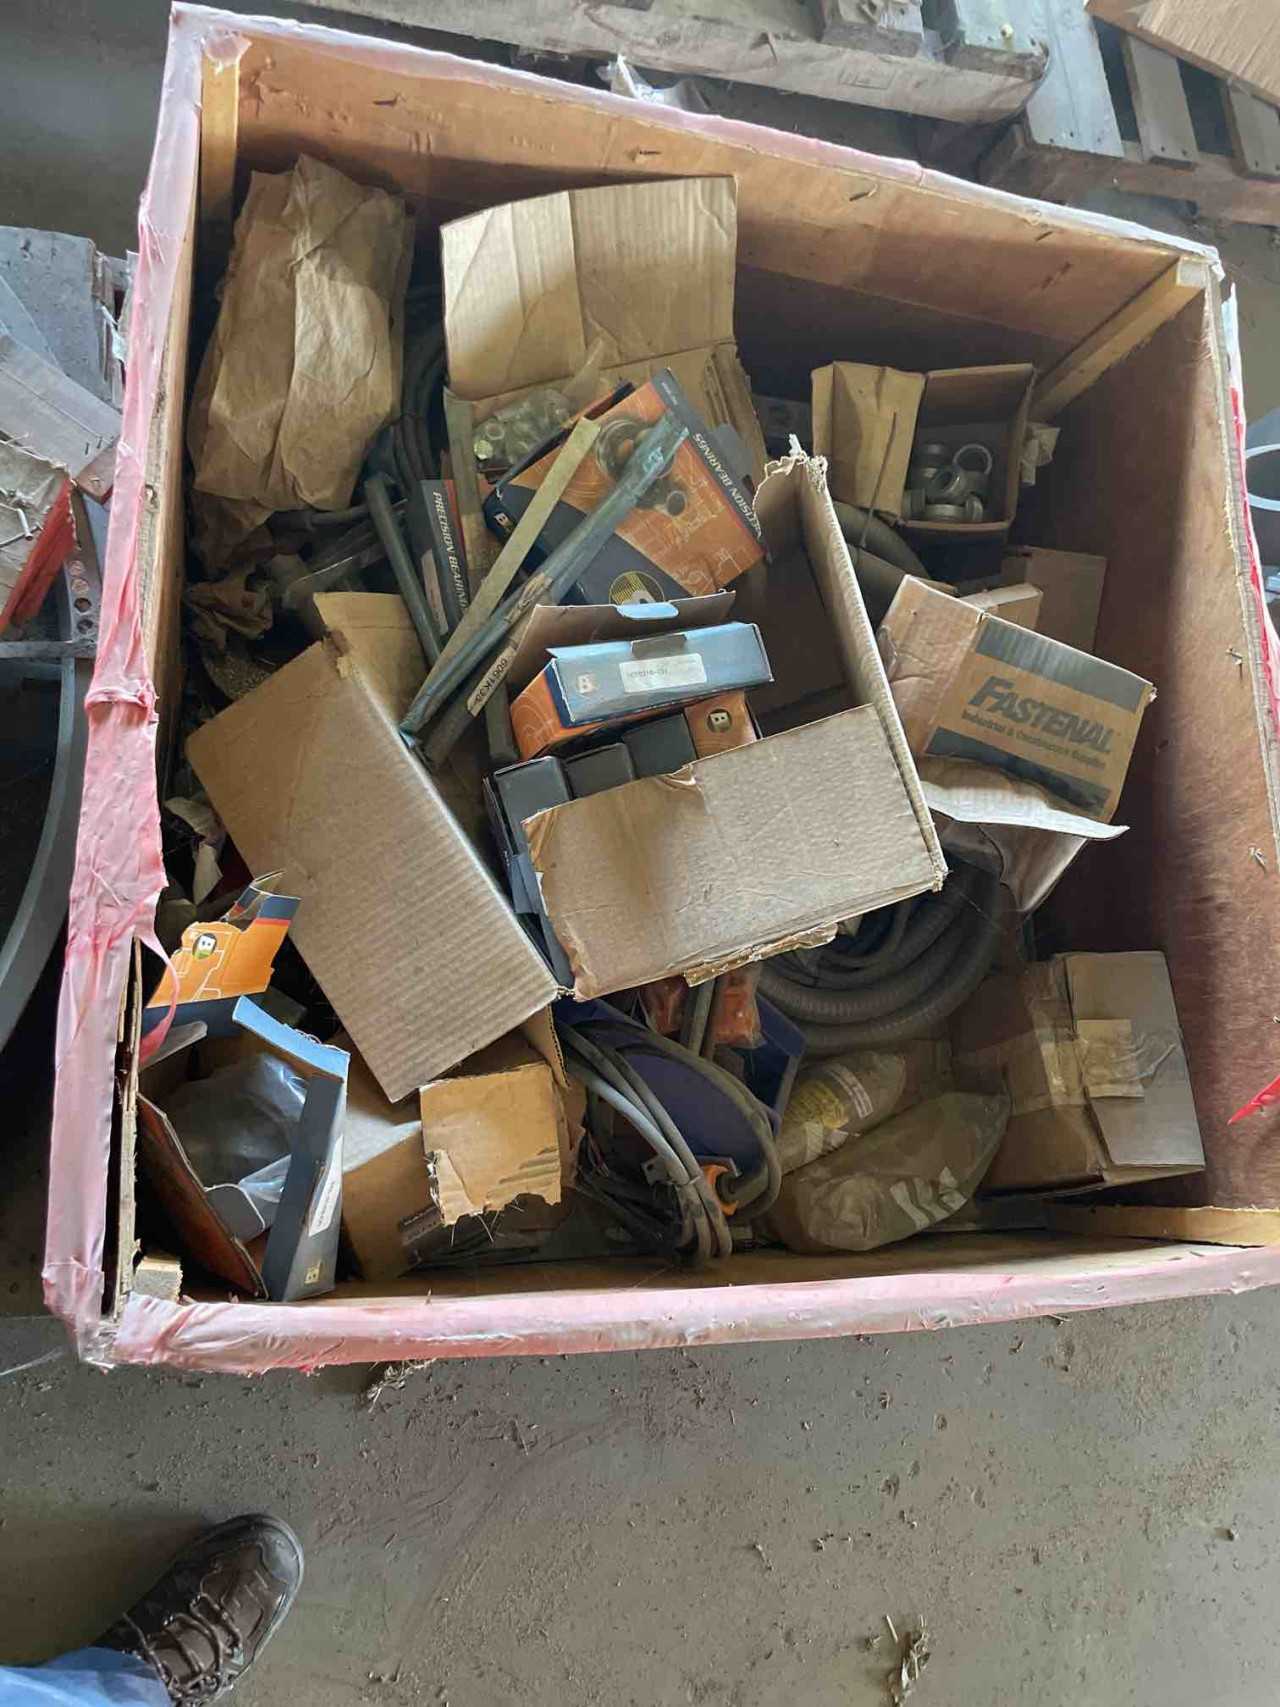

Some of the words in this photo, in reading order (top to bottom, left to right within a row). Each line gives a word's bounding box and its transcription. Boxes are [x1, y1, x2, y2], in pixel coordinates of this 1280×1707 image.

[693, 433, 732, 487] BEARINGS
[432, 491, 455, 553] PRECISION
[448, 555, 469, 608] BEARING
